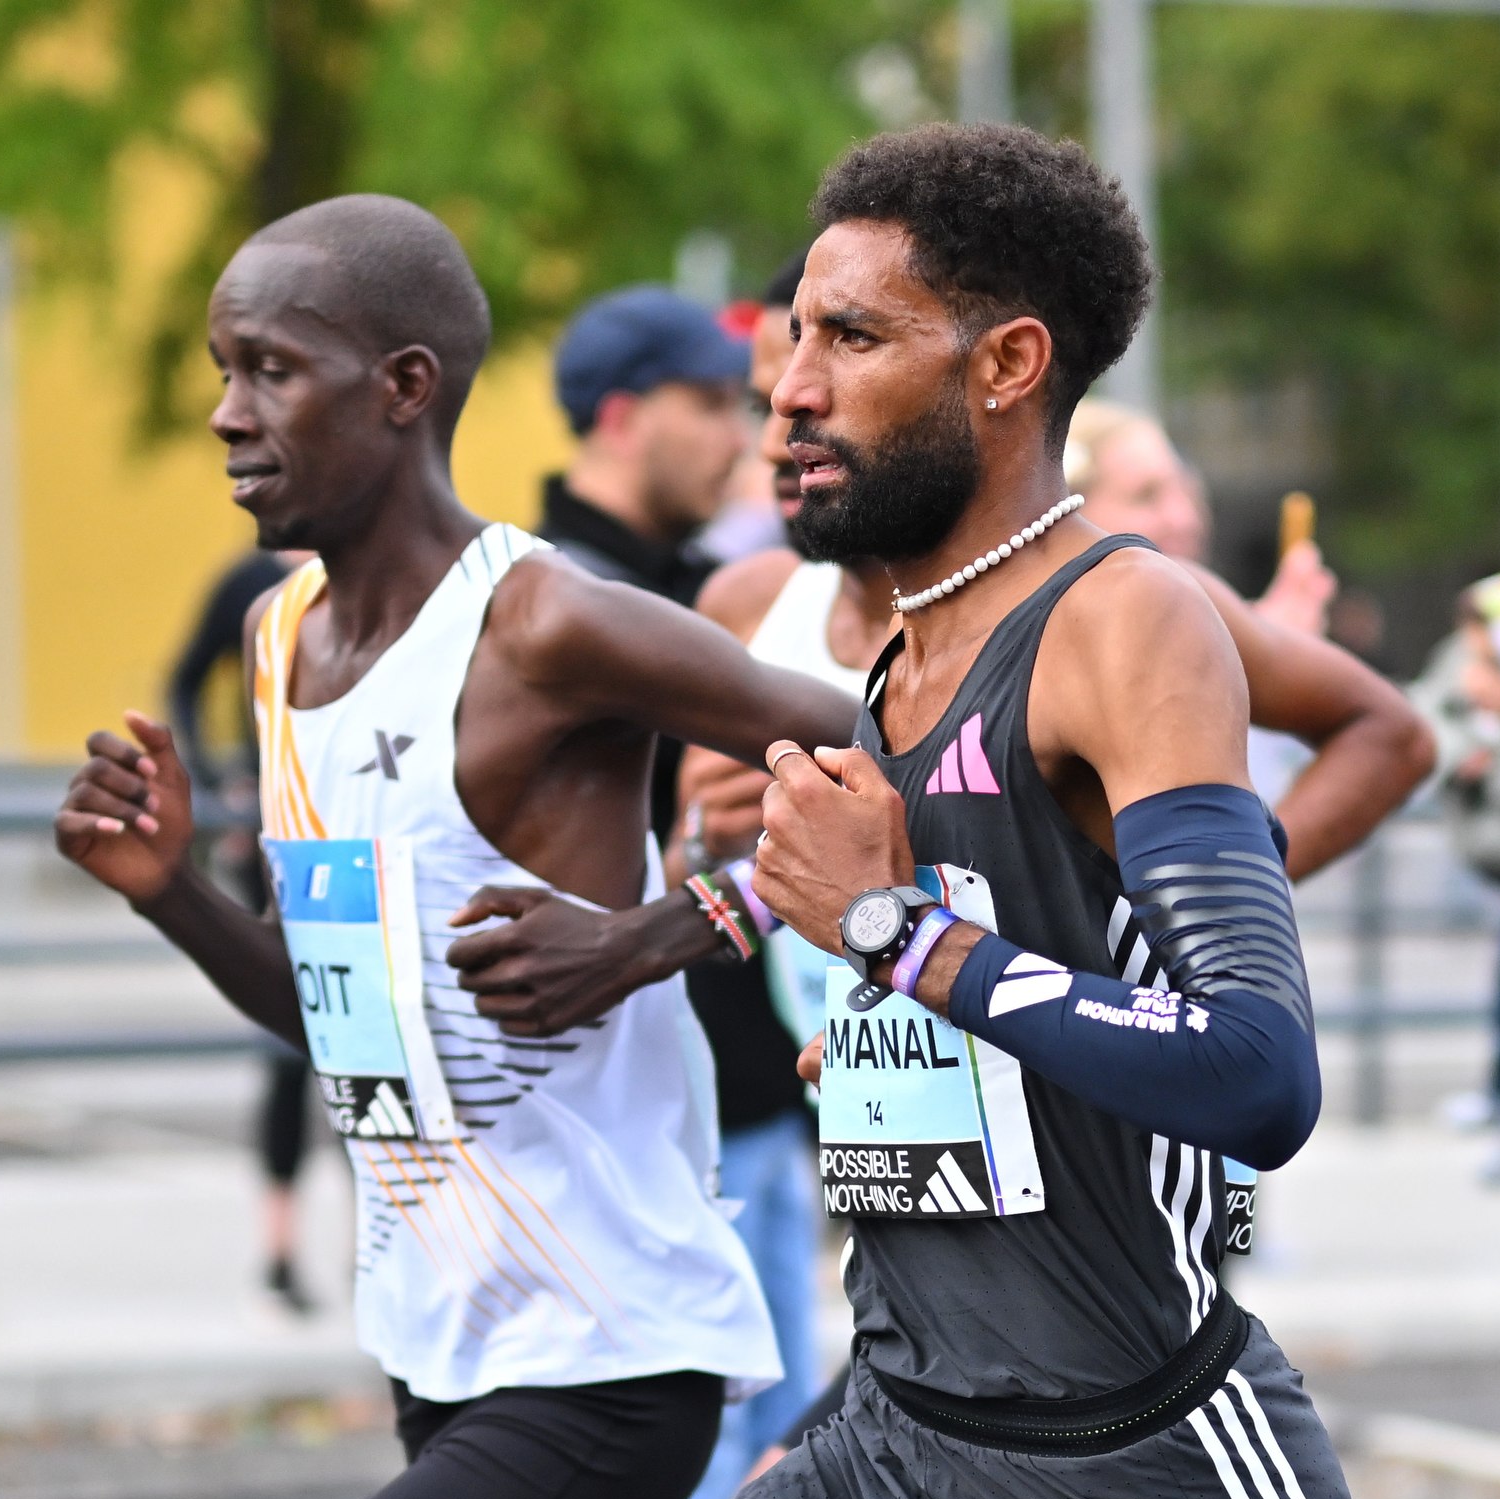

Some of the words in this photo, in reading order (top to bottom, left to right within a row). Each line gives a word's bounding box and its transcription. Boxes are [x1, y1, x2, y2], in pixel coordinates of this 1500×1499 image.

[1074, 998, 1178, 1034] MARATHON
[865, 1100, 884, 1127] 14
[824, 1184, 914, 1213] NOTHING
